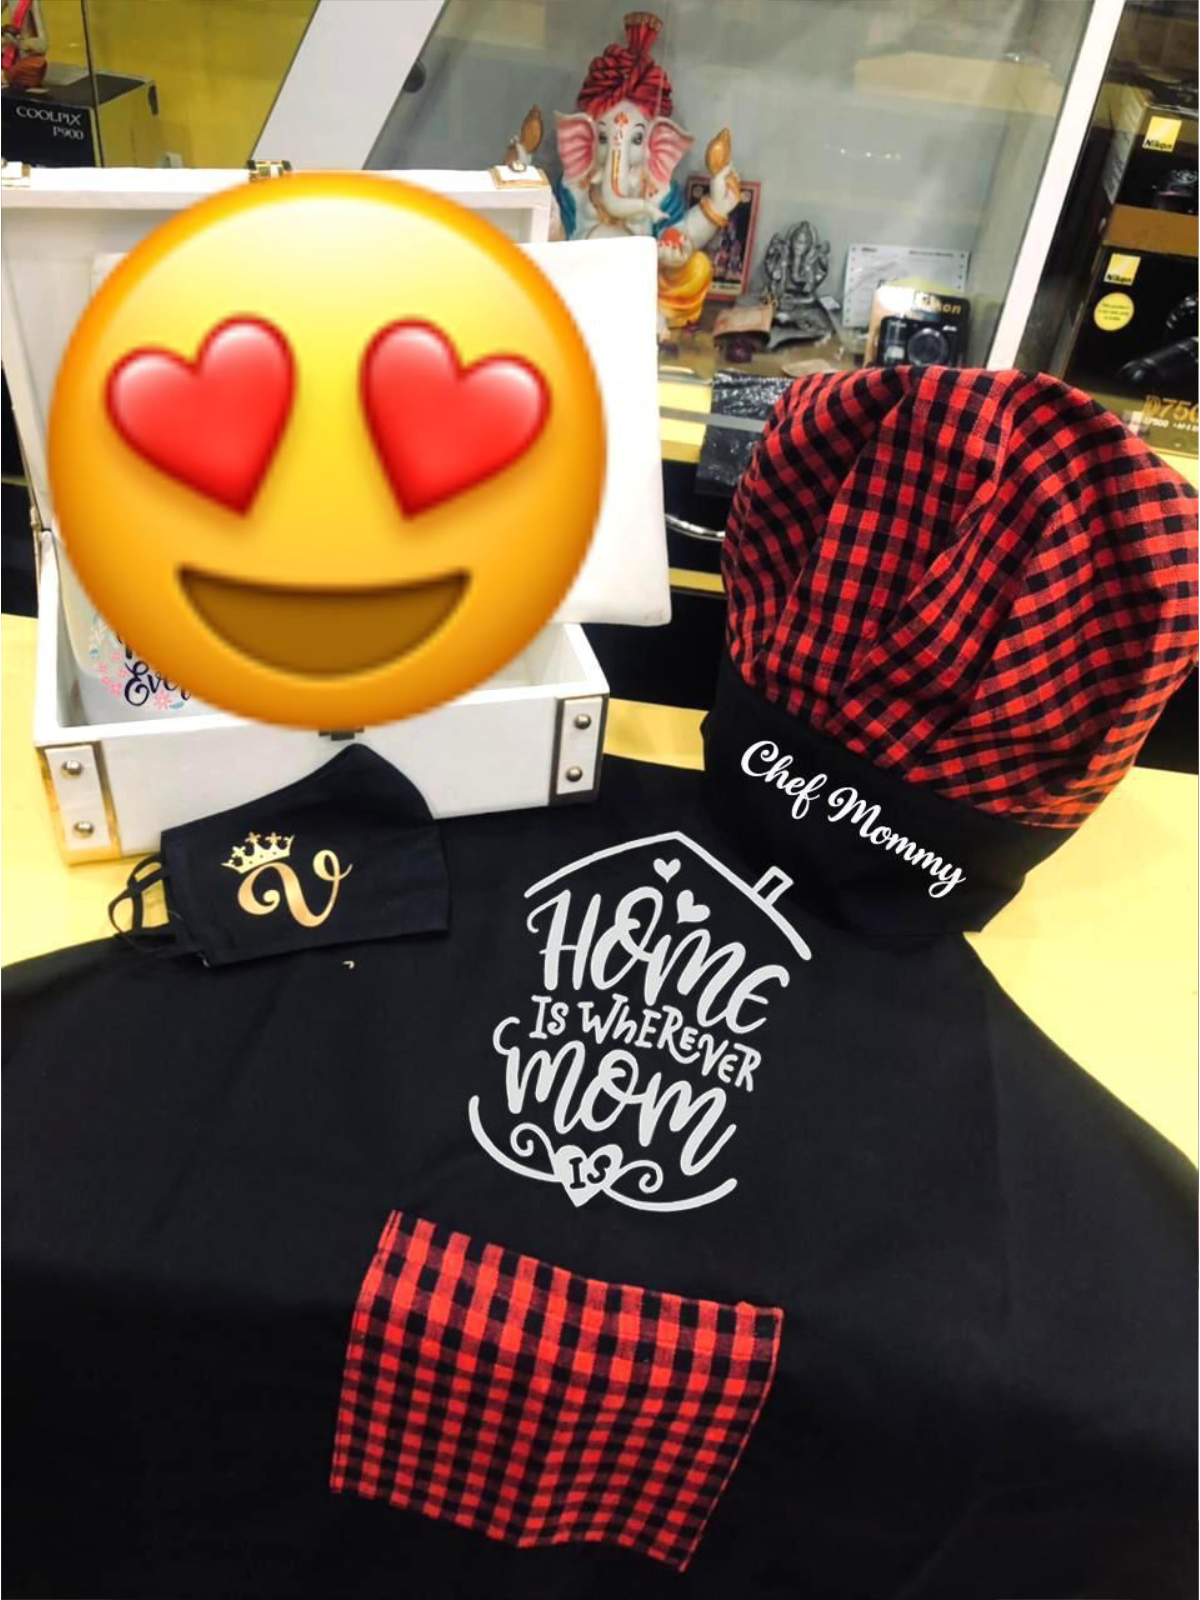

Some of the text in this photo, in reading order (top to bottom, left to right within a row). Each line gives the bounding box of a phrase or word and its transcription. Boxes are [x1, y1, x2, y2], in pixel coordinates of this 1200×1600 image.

[15, 105, 82, 126] COOLPIX
[52, 125, 85, 141] P900
[741, 740, 967, 898] Chef Mommy
[528, 994, 570, 1040] IS
[569, 1153, 612, 1190] IS
